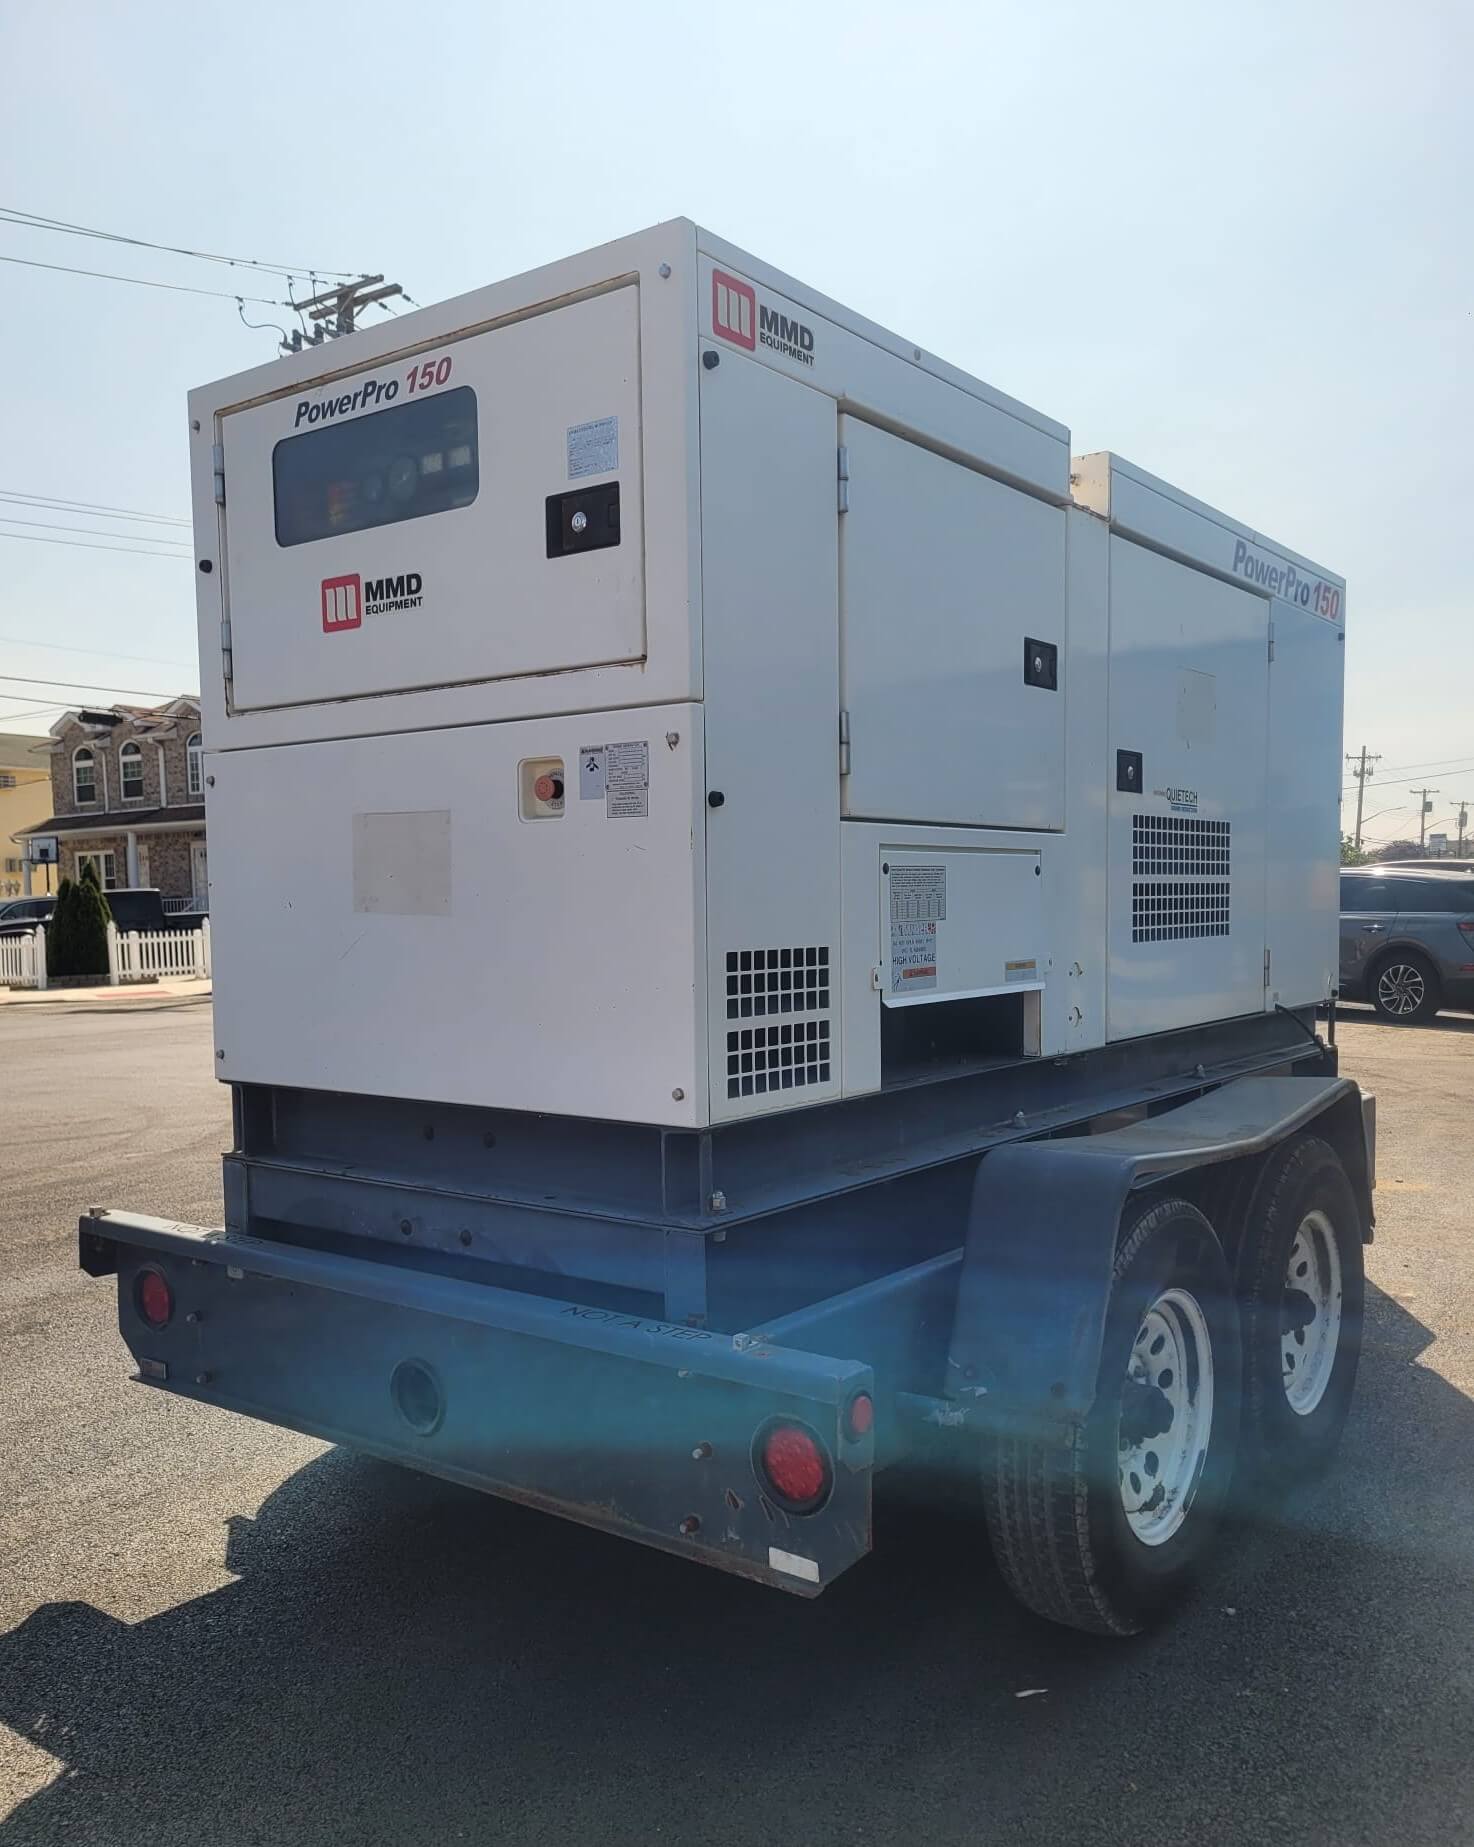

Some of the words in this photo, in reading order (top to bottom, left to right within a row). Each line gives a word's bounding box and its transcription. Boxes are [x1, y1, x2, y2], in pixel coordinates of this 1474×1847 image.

[759, 303, 814, 351] MMD
[760, 331, 815, 366] EQUIPMENT
[294, 380, 399, 427] PowerPro
[406, 356, 453, 394] 150
[365, 573, 422, 602] MMD
[1232, 538, 1310, 606] PowerPro
[1313, 581, 1340, 619] 150
[366, 597, 423, 615] EQUIPMENT
[1167, 787, 1198, 804] QUIETECH
[892, 956, 907, 966] HIGH
[909, 953, 936, 964] VOLTAGE
[560, 1306, 625, 1322] NOT
[616, 1320, 643, 1329] A
[646, 1324, 713, 1340] STEP
